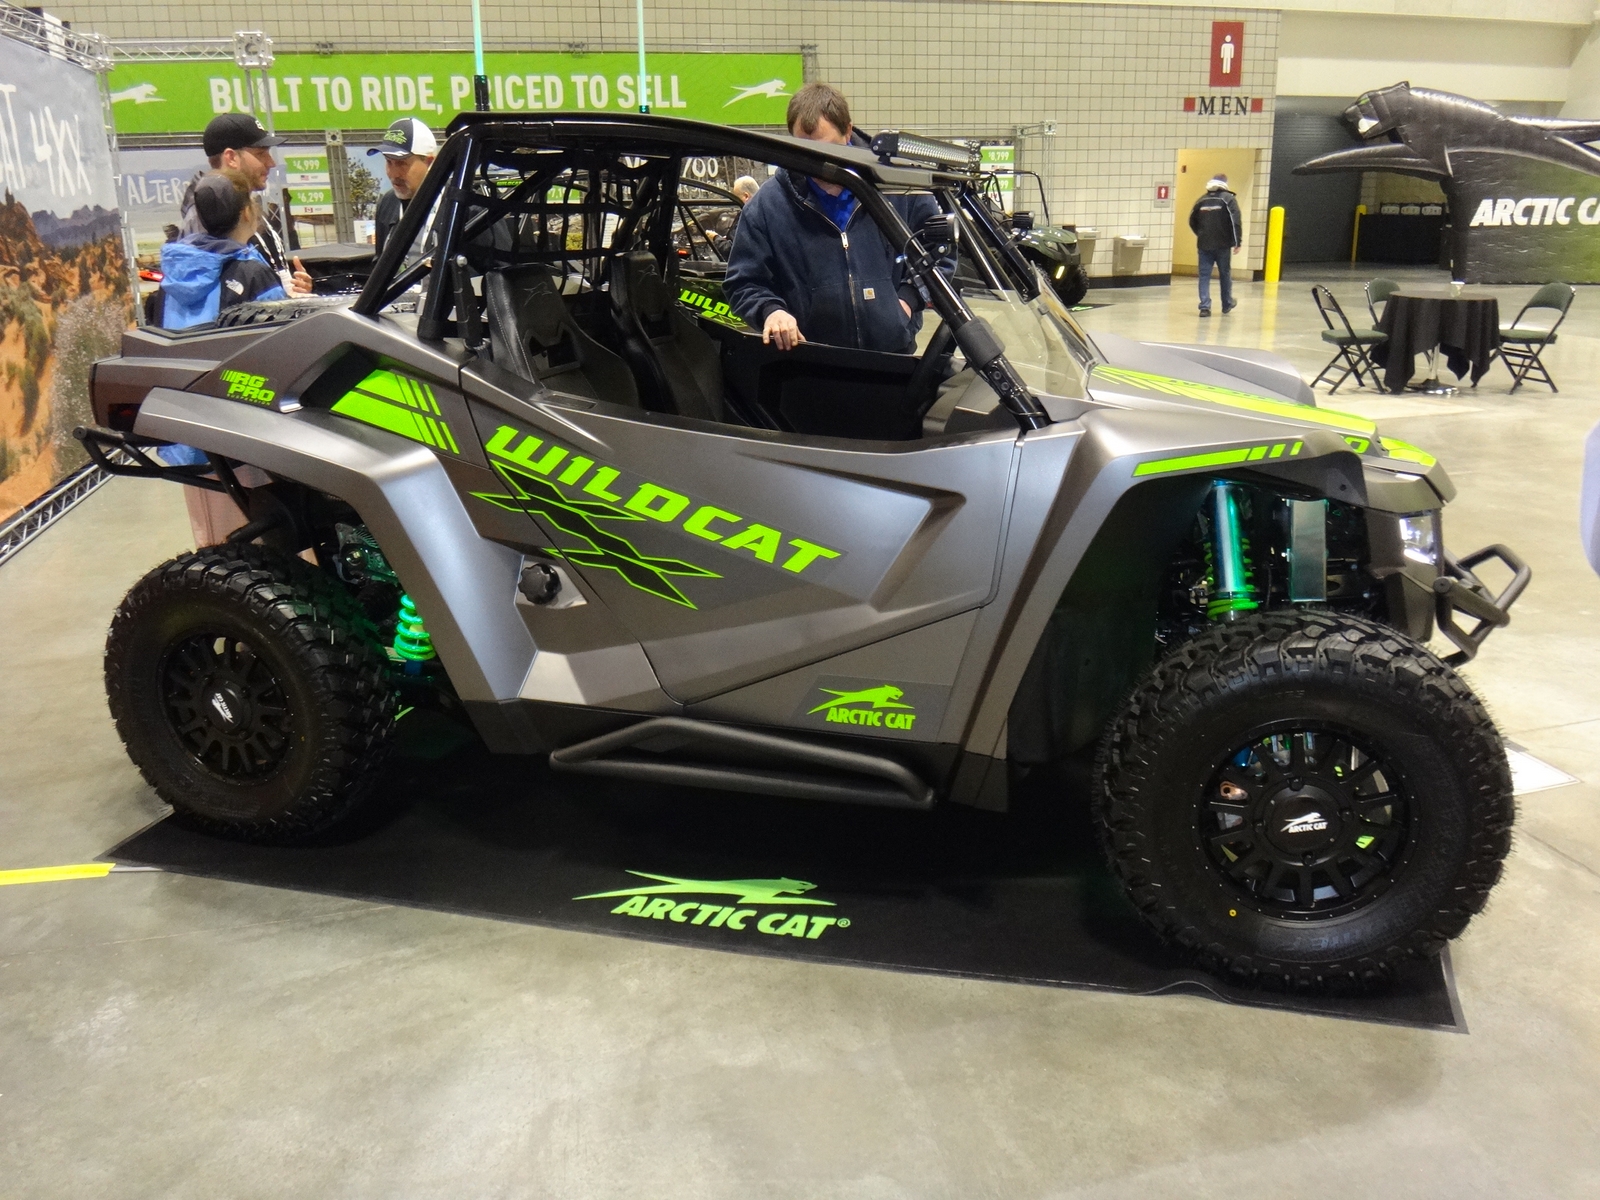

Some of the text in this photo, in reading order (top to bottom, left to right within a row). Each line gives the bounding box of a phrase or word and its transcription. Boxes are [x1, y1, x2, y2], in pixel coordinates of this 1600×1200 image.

[209, 74, 687, 116] BUILT TO RIDE, PICED TO SELL
[1198, 95, 1249, 116] MEN
[126, 174, 191, 206] ALTER
[1469, 197, 1576, 227] ARCTIC
[228, 383, 275, 402] PRO
[485, 425, 841, 574] WILDCAT
[825, 706, 916, 730] ARCTIC CAT
[611, 896, 757, 930] ARCTIC
